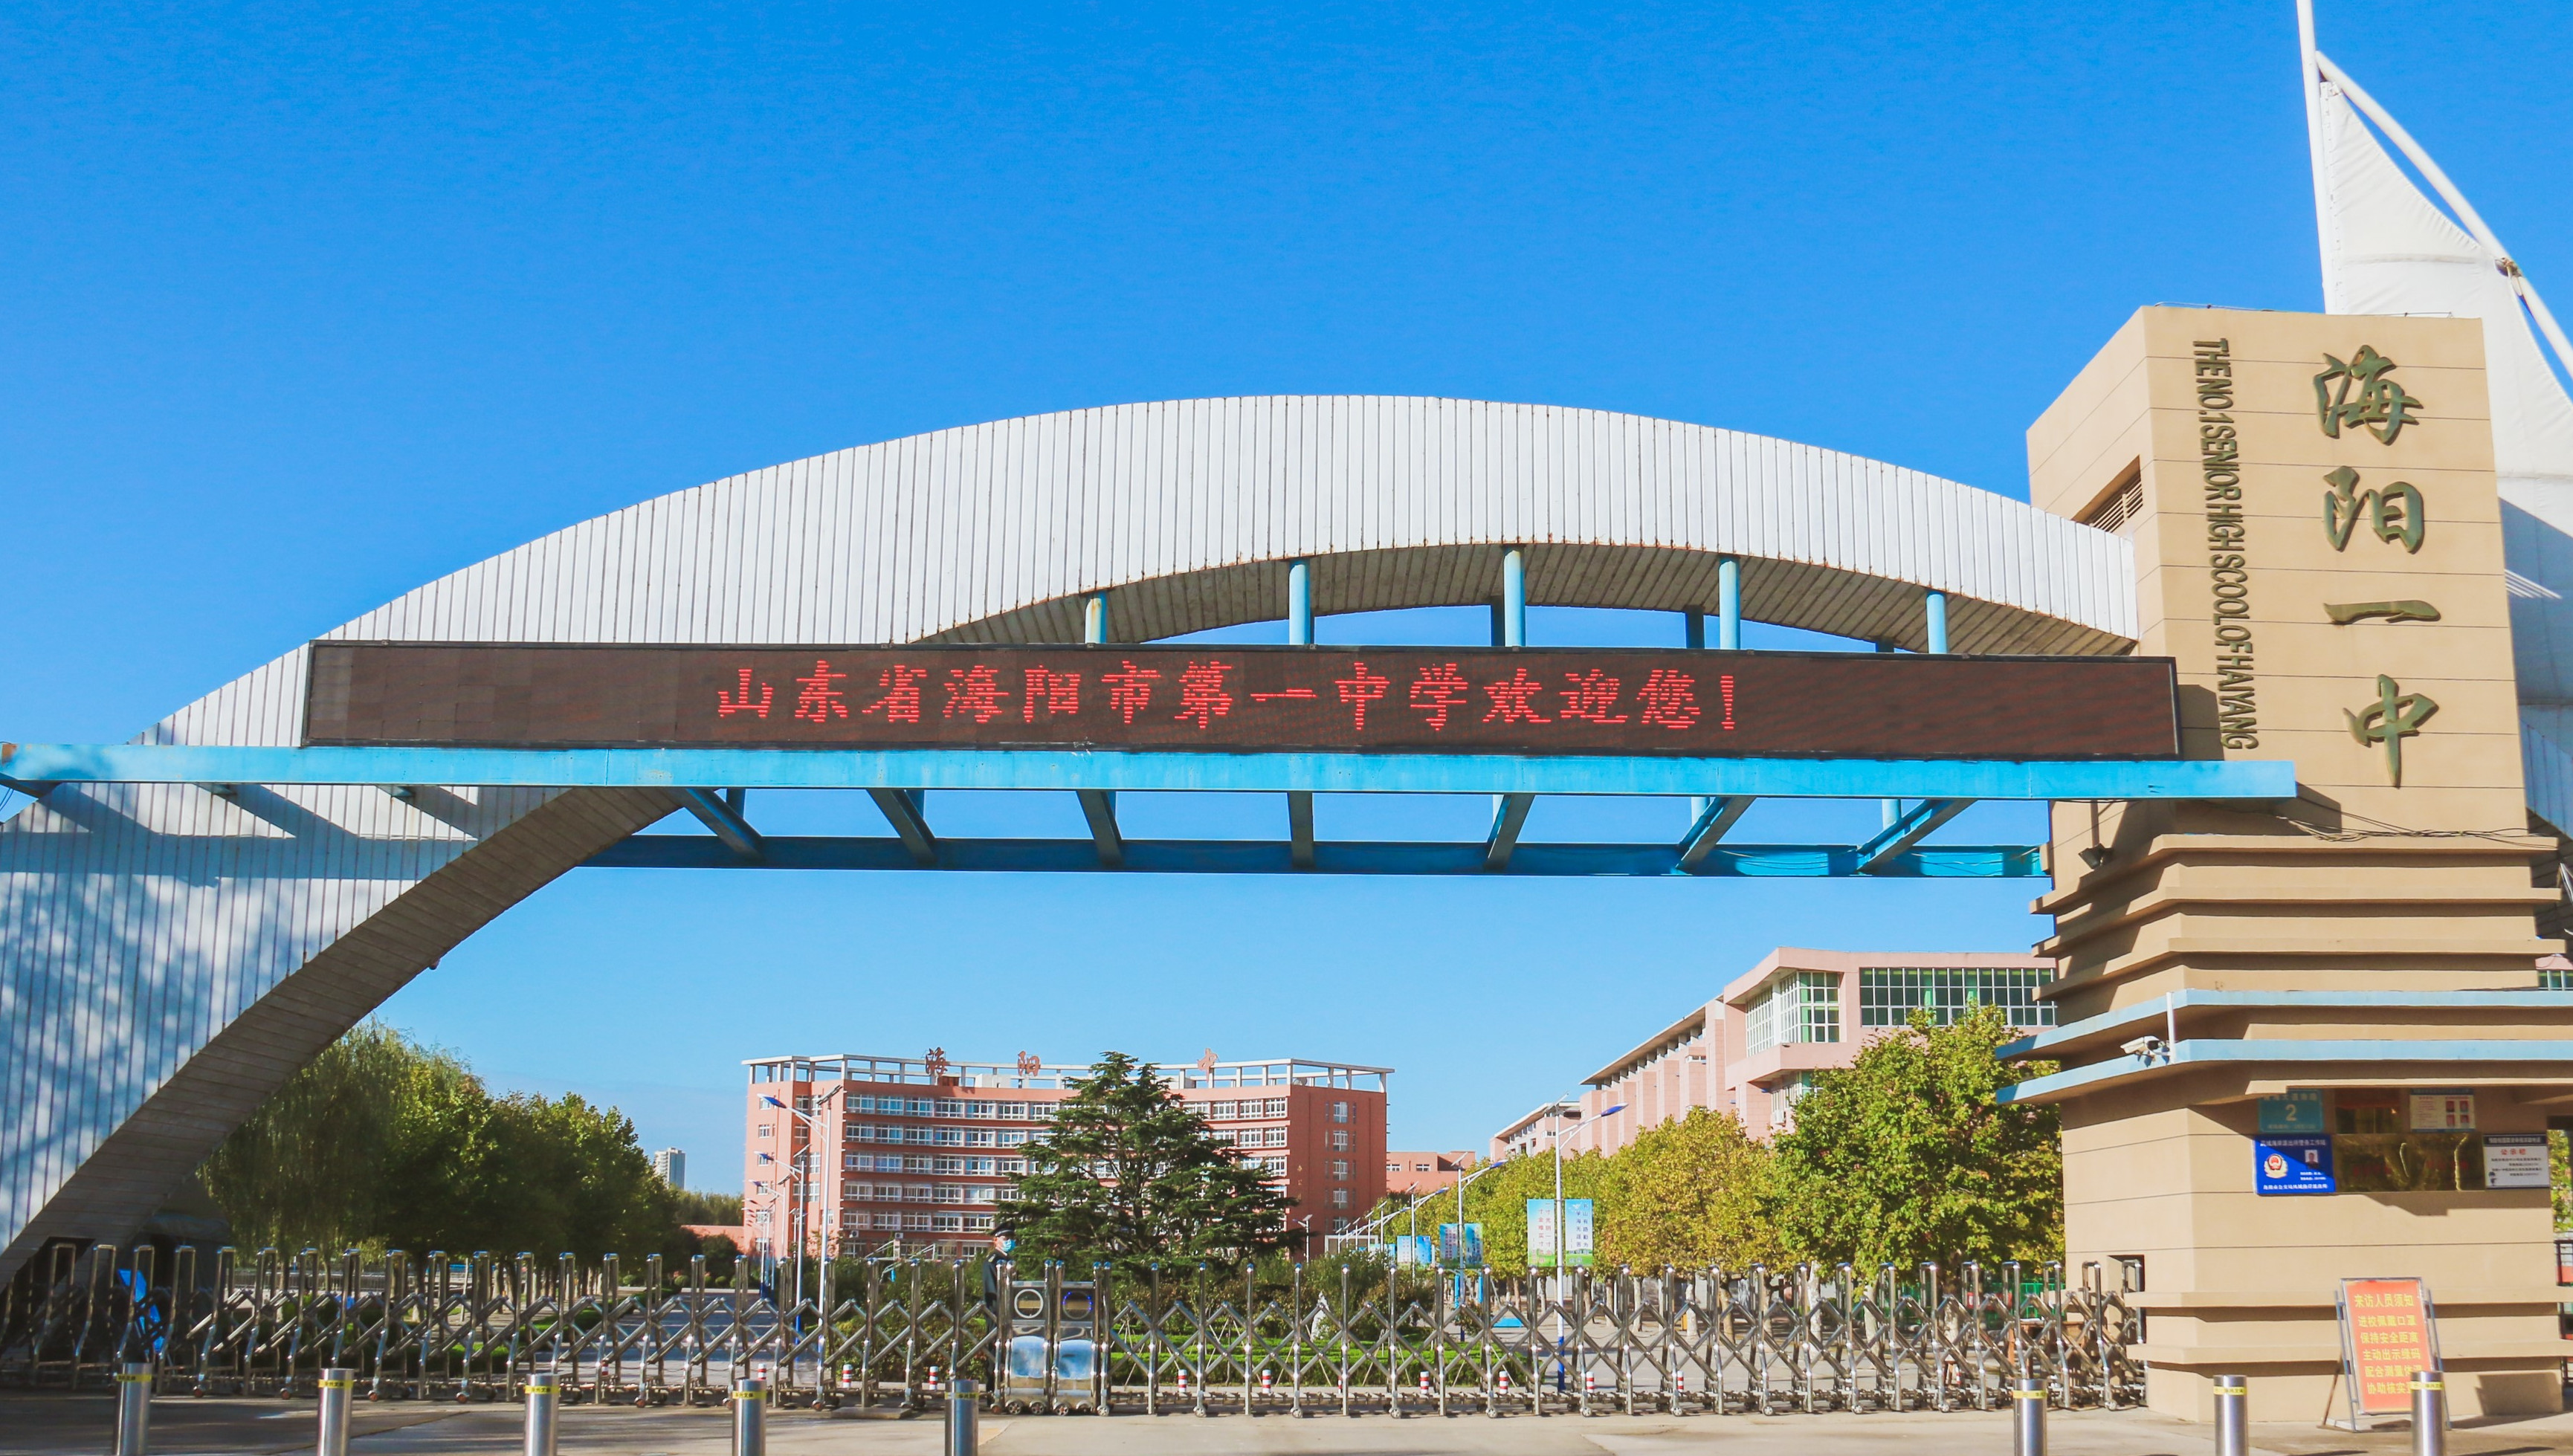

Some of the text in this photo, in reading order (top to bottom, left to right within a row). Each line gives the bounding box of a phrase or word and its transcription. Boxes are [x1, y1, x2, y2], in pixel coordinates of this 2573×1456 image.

[2193, 338, 2259, 750] THE NO.1 SENIOR HIGH SCOOL OF HAIYANG
[2313, 344, 2441, 789] 海阳一中
[2285, 1104, 2296, 1122] 2
[2354, 1293, 2415, 1308] 来访人员须知
[2358, 1314, 2418, 1327] 进校佩戴口罩
[2360, 1331, 2419, 1344] 保持安全距离
[2363, 1348, 2421, 1360] 主动出示绿码
